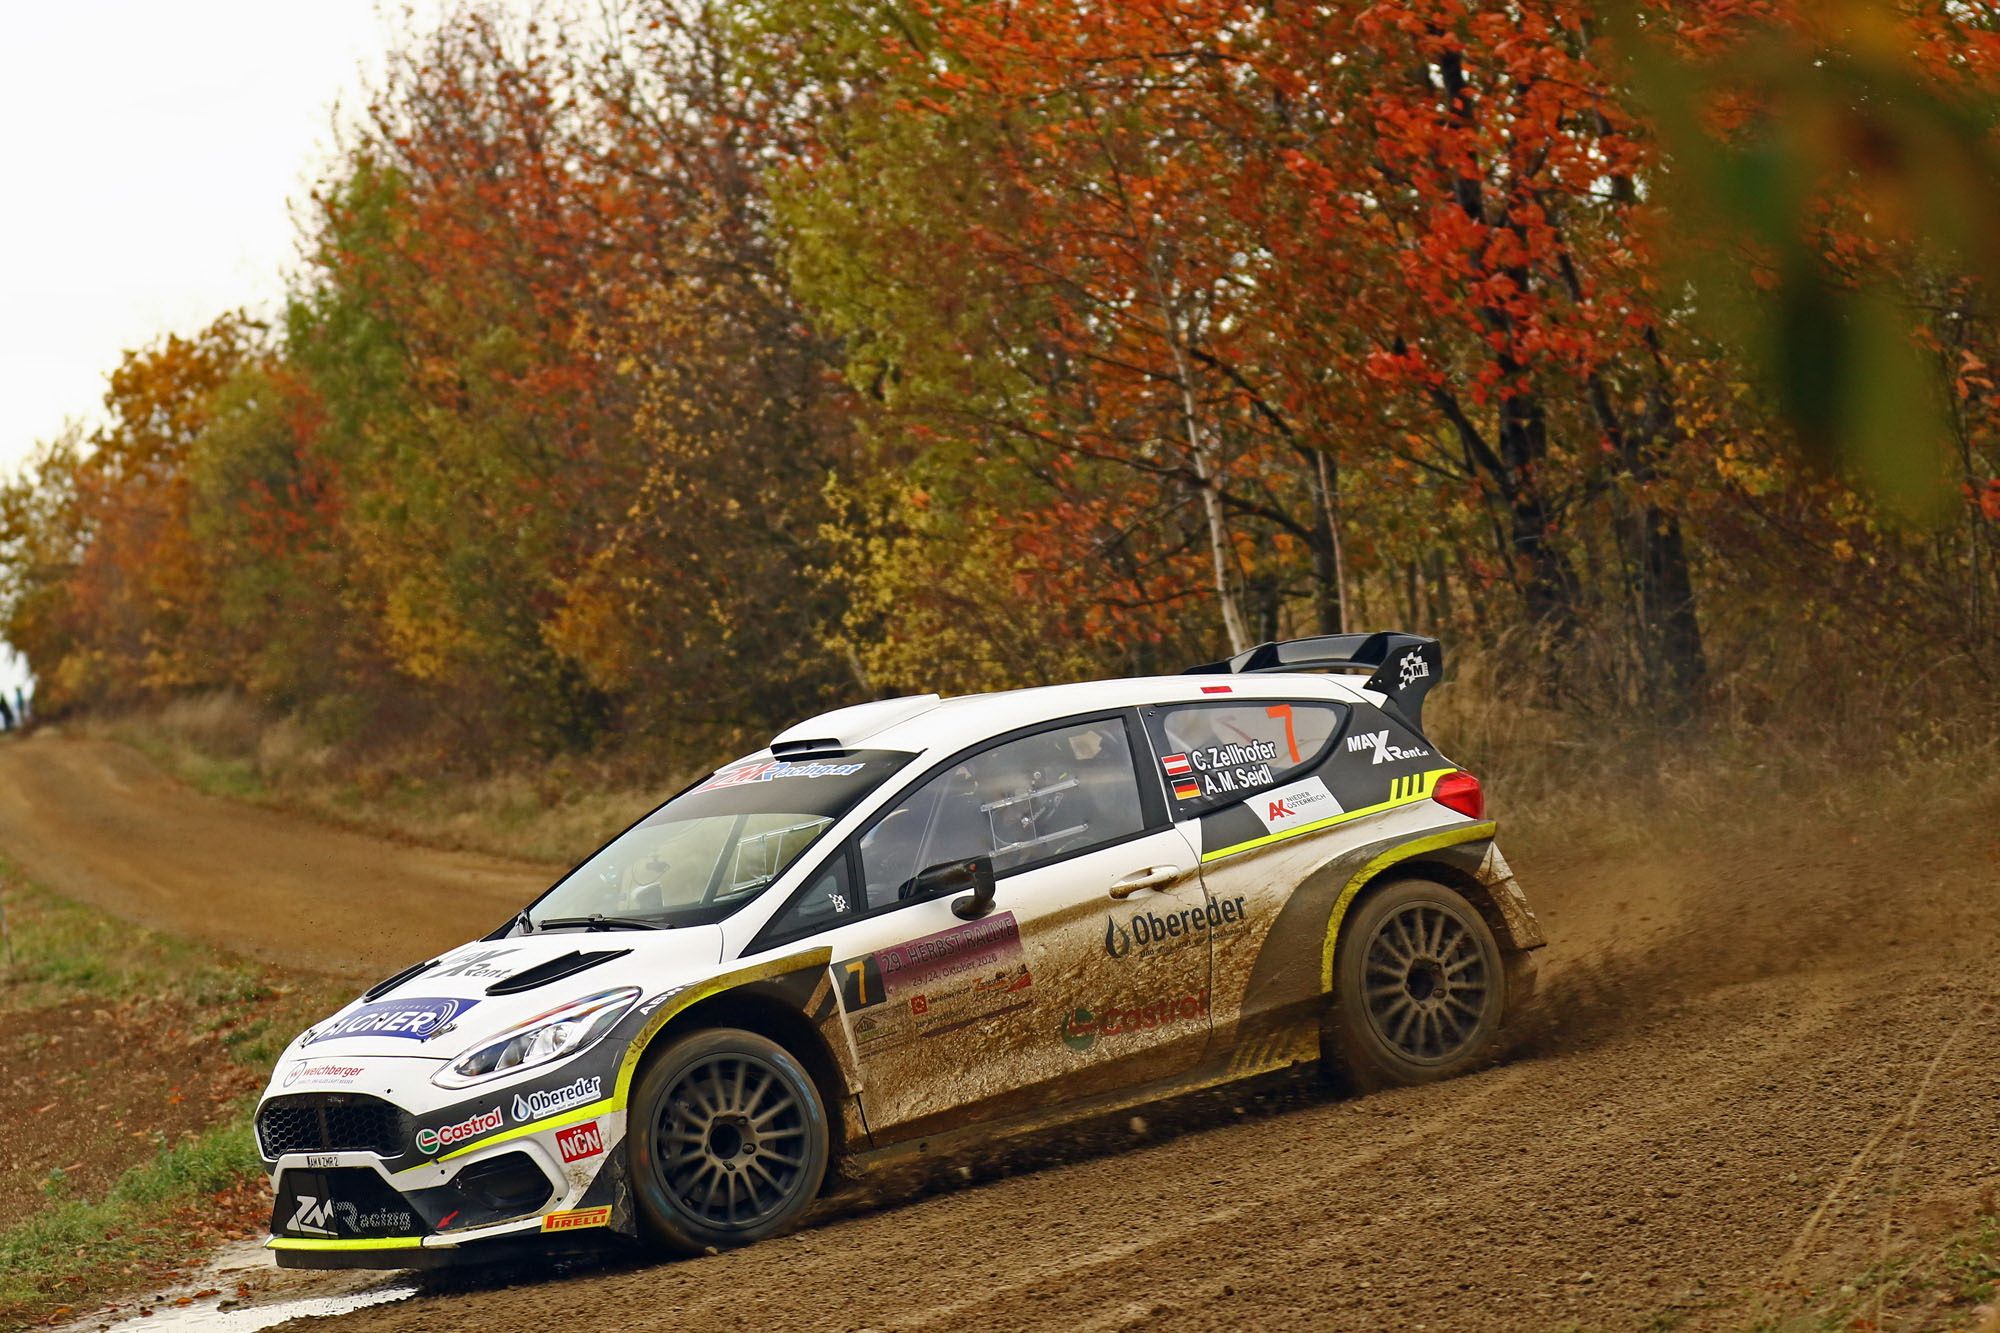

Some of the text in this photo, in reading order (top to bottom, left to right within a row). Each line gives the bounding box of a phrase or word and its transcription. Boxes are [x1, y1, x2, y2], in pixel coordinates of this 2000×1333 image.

[1265, 703, 1300, 763] 7
[1192, 739, 1276, 772] C. Zellhofer
[1236, 763, 1275, 789] Seidl
[1269, 799, 1296, 821] AK
[1286, 791, 1312, 803] NIEDER
[1132, 896, 1245, 946] Obereder
[882, 918, 1015, 974] 29. HERBST RALLYE
[844, 960, 867, 1005] 7
[942, 962, 976, 977] Oktober
[316, 1011, 437, 1039] AIGNER
[1102, 988, 1207, 1036] Castrol
[303, 1064, 365, 1078] weichberger
[530, 1078, 600, 1112] Obereder
[439, 1109, 502, 1144] Castrol
[560, 1129, 601, 1159] NÖN
[336, 1200, 411, 1233] Racing
[546, 1208, 608, 1230] PIRELLI
